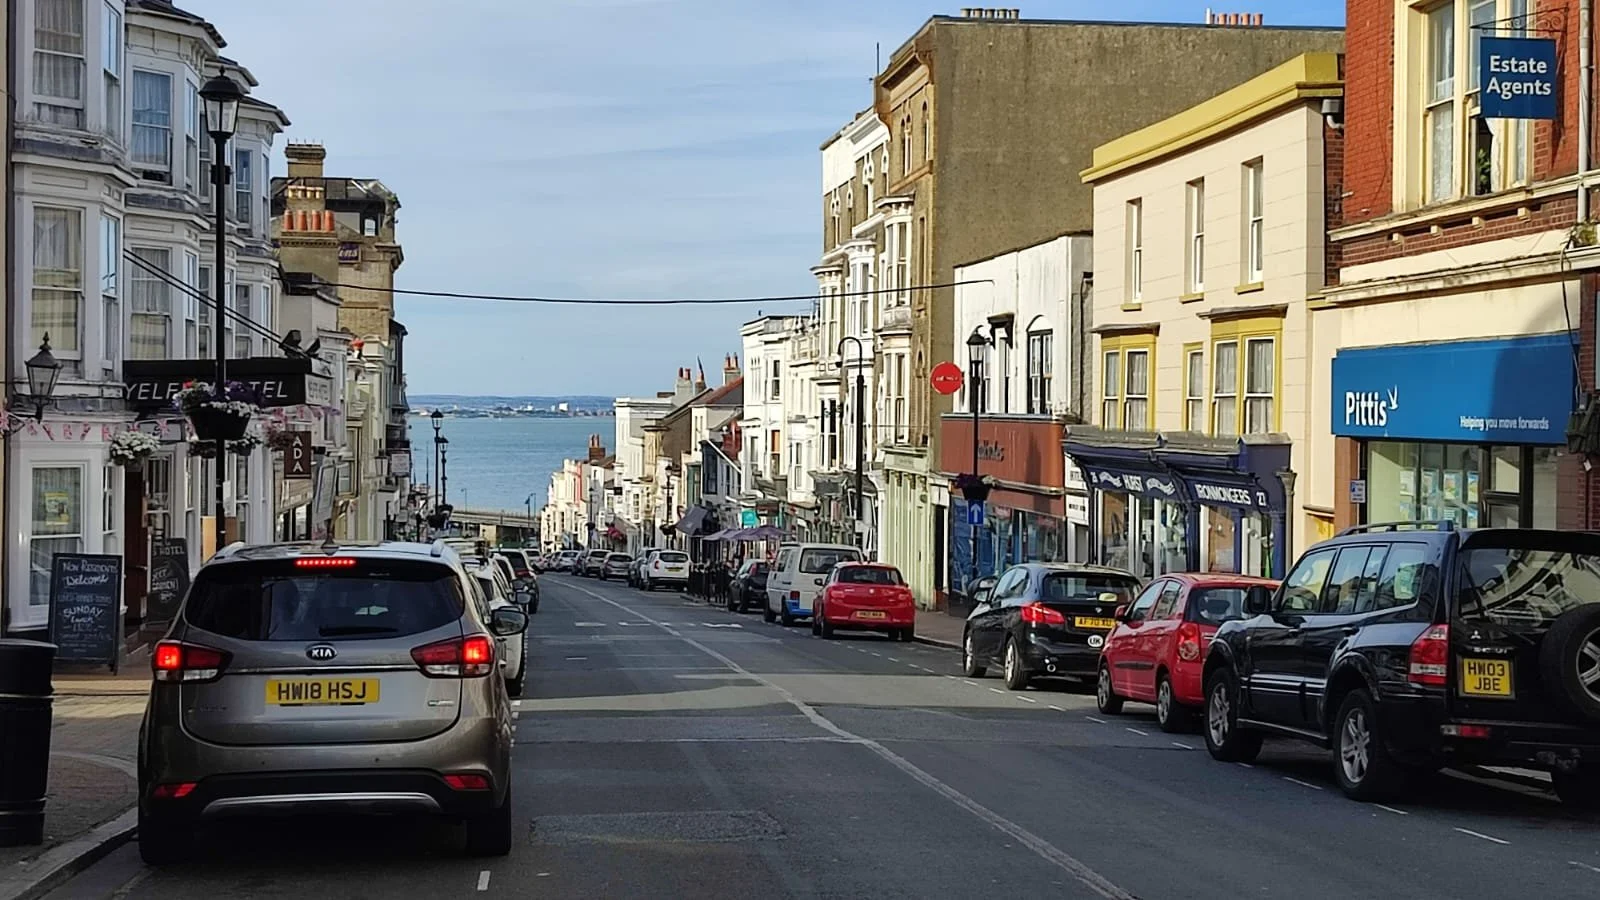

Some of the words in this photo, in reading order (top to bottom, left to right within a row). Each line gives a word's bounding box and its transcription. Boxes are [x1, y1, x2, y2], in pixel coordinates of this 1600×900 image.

[1490, 55, 1547, 73] Estate
[1486, 76, 1551, 100] Agents
[1345, 391, 1387, 426] Pittis
[1460, 416, 1484, 431] Helping
[1485, 418, 1498, 431] you
[1499, 418, 1517, 429] move
[1518, 416, 1549, 430] forwards
[1194, 484, 1252, 505] IRONMONGERS
[311, 648, 333, 658] KIA
[1468, 661, 1505, 677] HW03
[277, 682, 322, 701] HW18
[328, 681, 367, 700] HSJ
[1474, 677, 1501, 692] JBE
